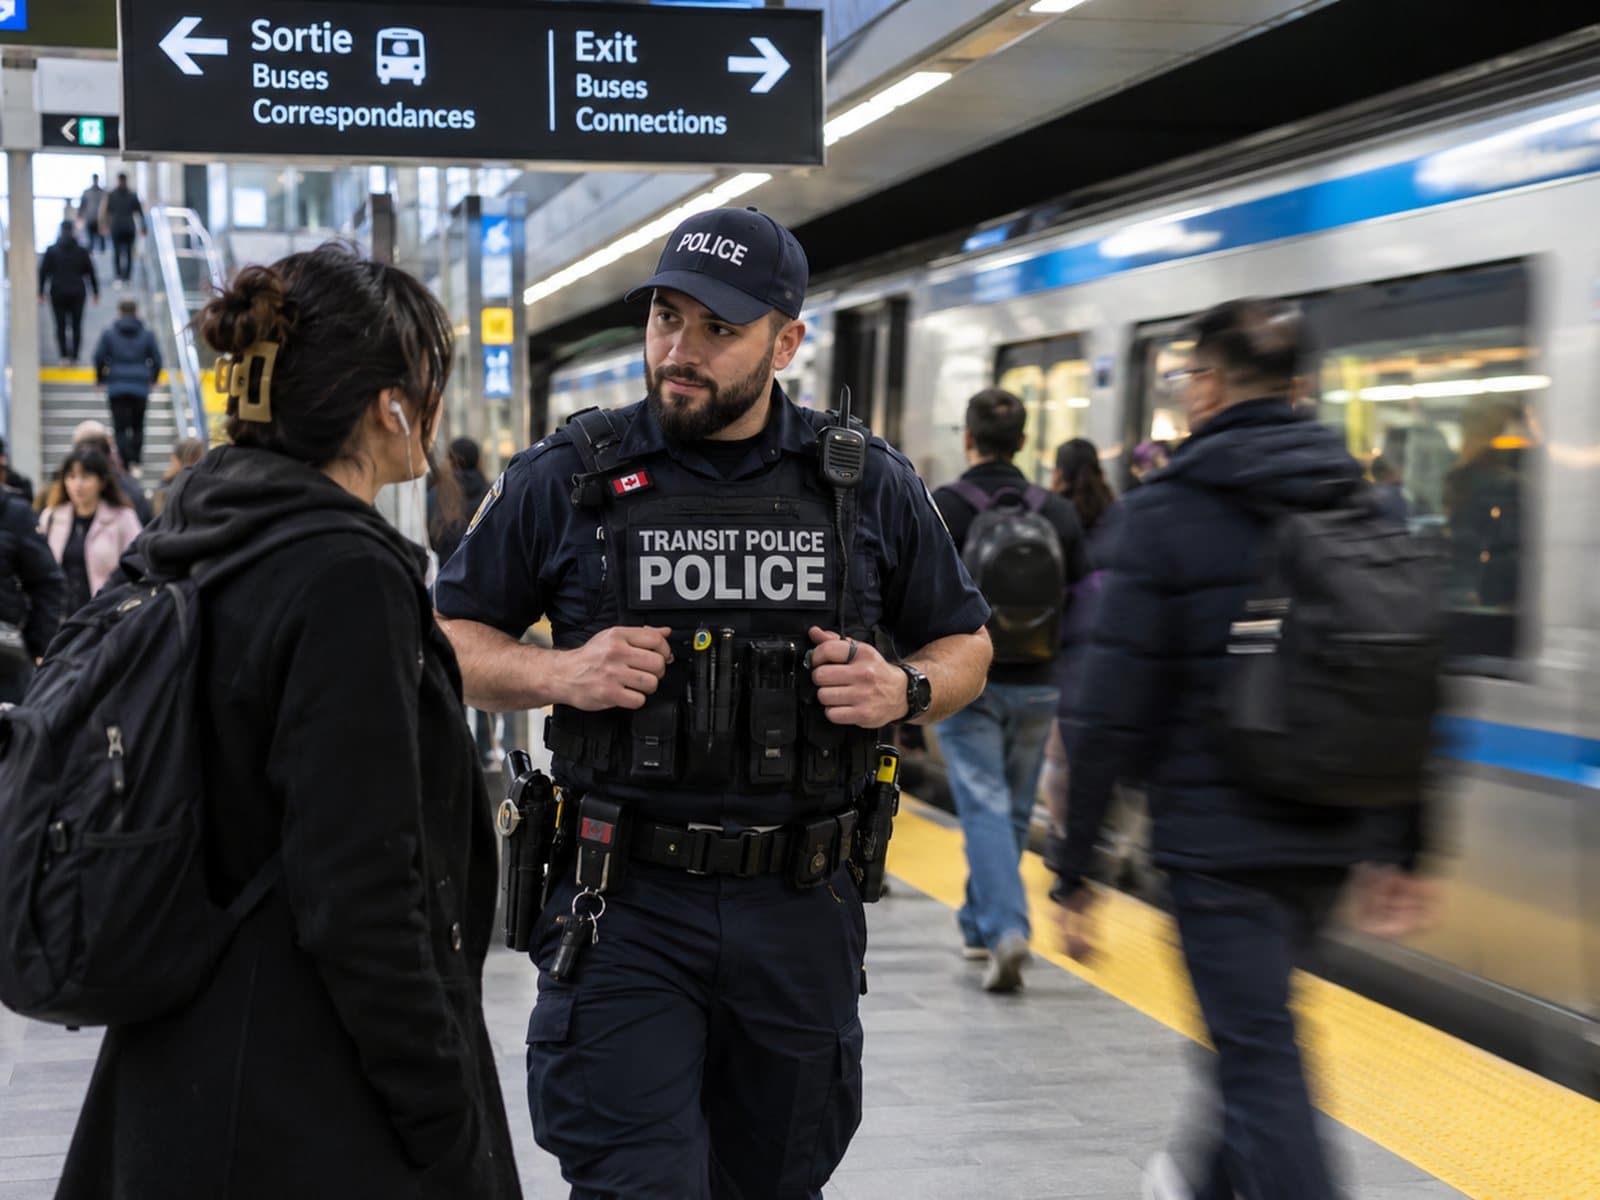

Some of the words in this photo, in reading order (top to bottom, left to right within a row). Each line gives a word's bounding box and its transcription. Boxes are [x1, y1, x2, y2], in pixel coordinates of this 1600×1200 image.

[251, 18, 353, 54] Sortie
[575, 30, 638, 64] Exit
[252, 63, 329, 90] Buses
[576, 73, 649, 100] Buses
[252, 98, 476, 132] Correspondances
[575, 106, 728, 135] Connections
[676, 231, 748, 267] POLICE
[639, 529, 740, 552] TRANSIT
[745, 529, 825, 553] POLICE
[639, 555, 826, 602] POLICE
